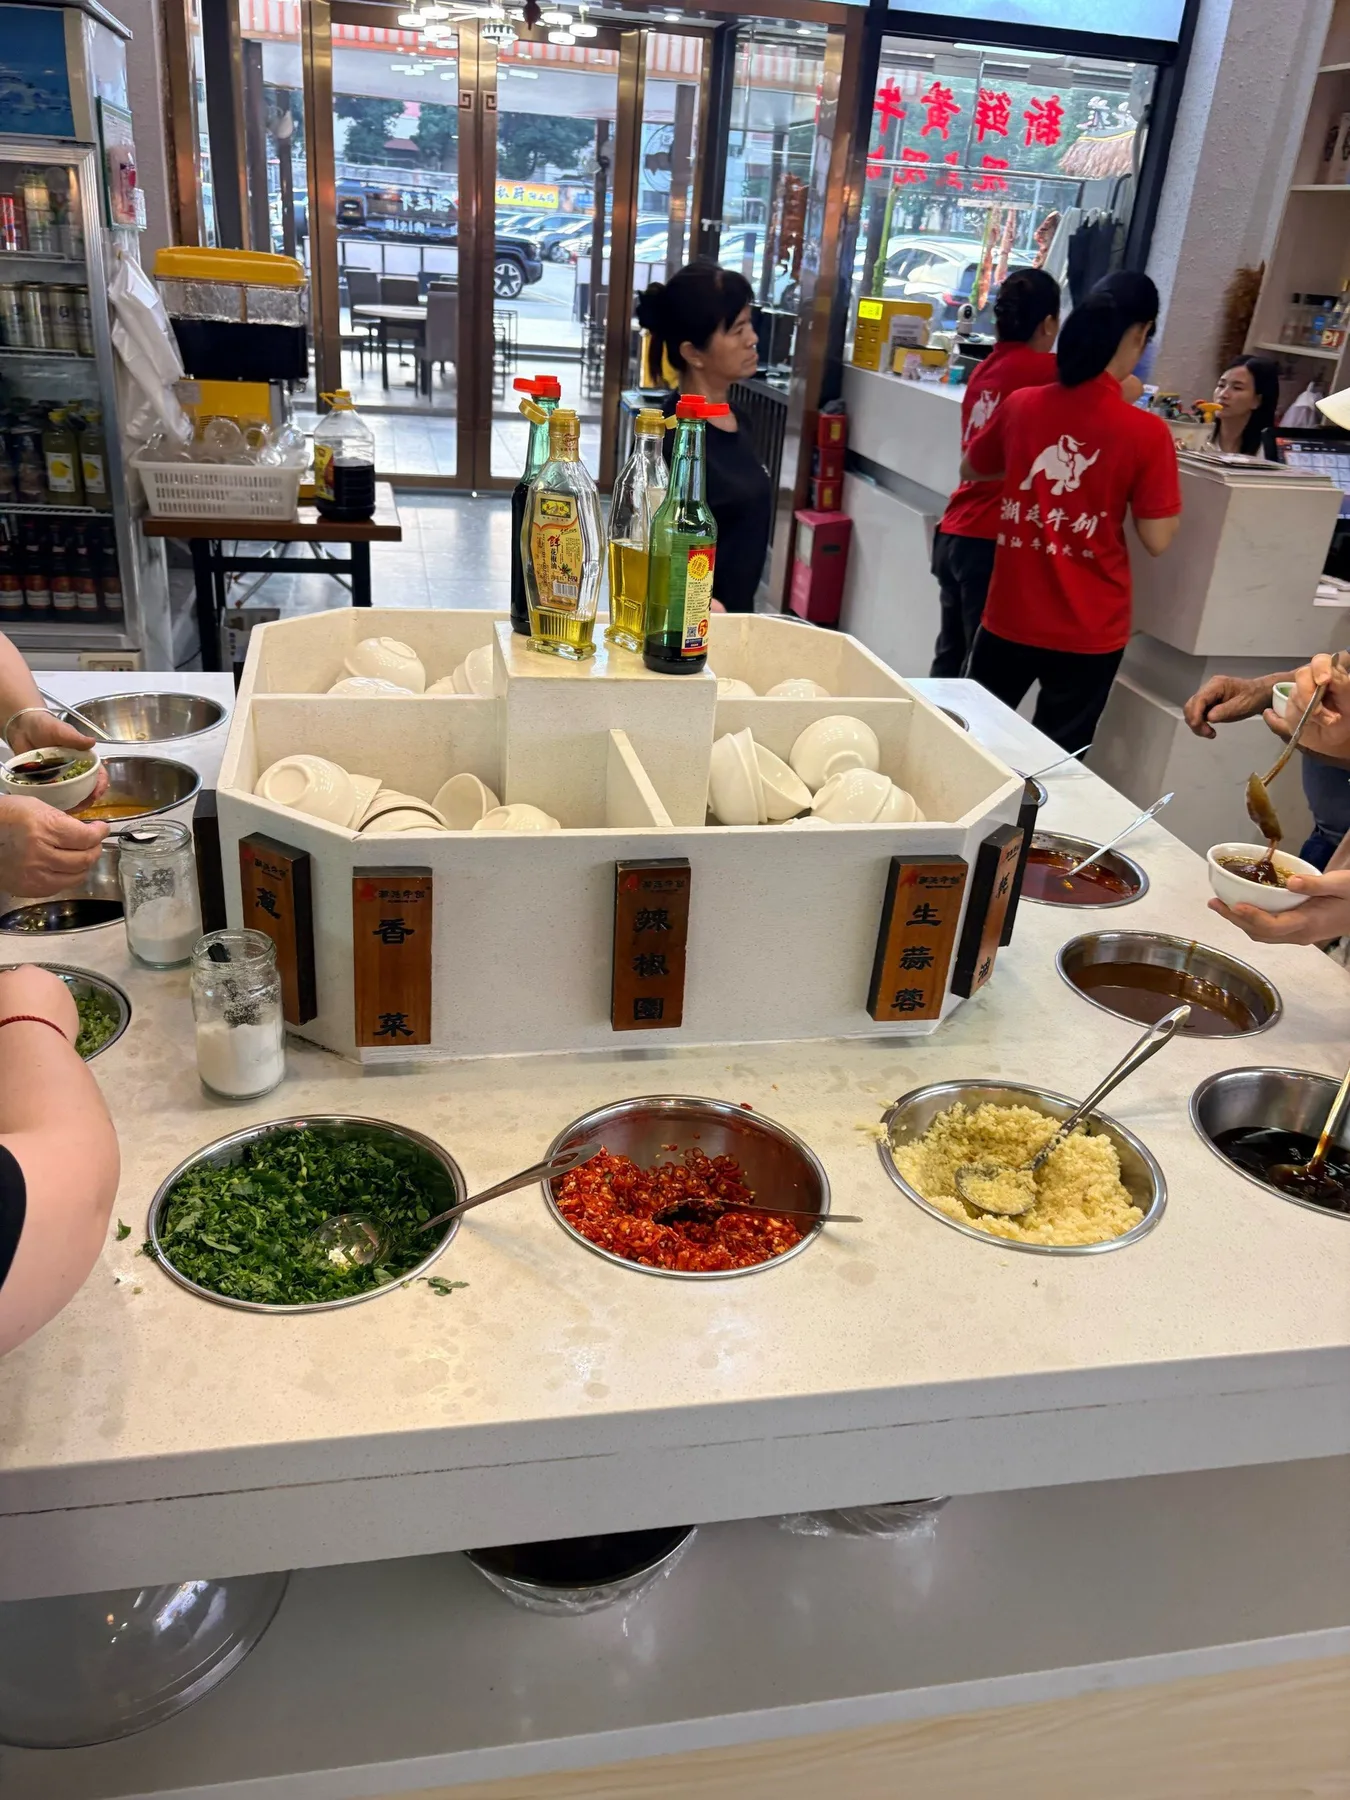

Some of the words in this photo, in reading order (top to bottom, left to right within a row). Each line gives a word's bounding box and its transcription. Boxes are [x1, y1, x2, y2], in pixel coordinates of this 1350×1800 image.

[372, 917, 415, 1038] 香菜
[890, 902, 943, 1012] 生蒜蓉
